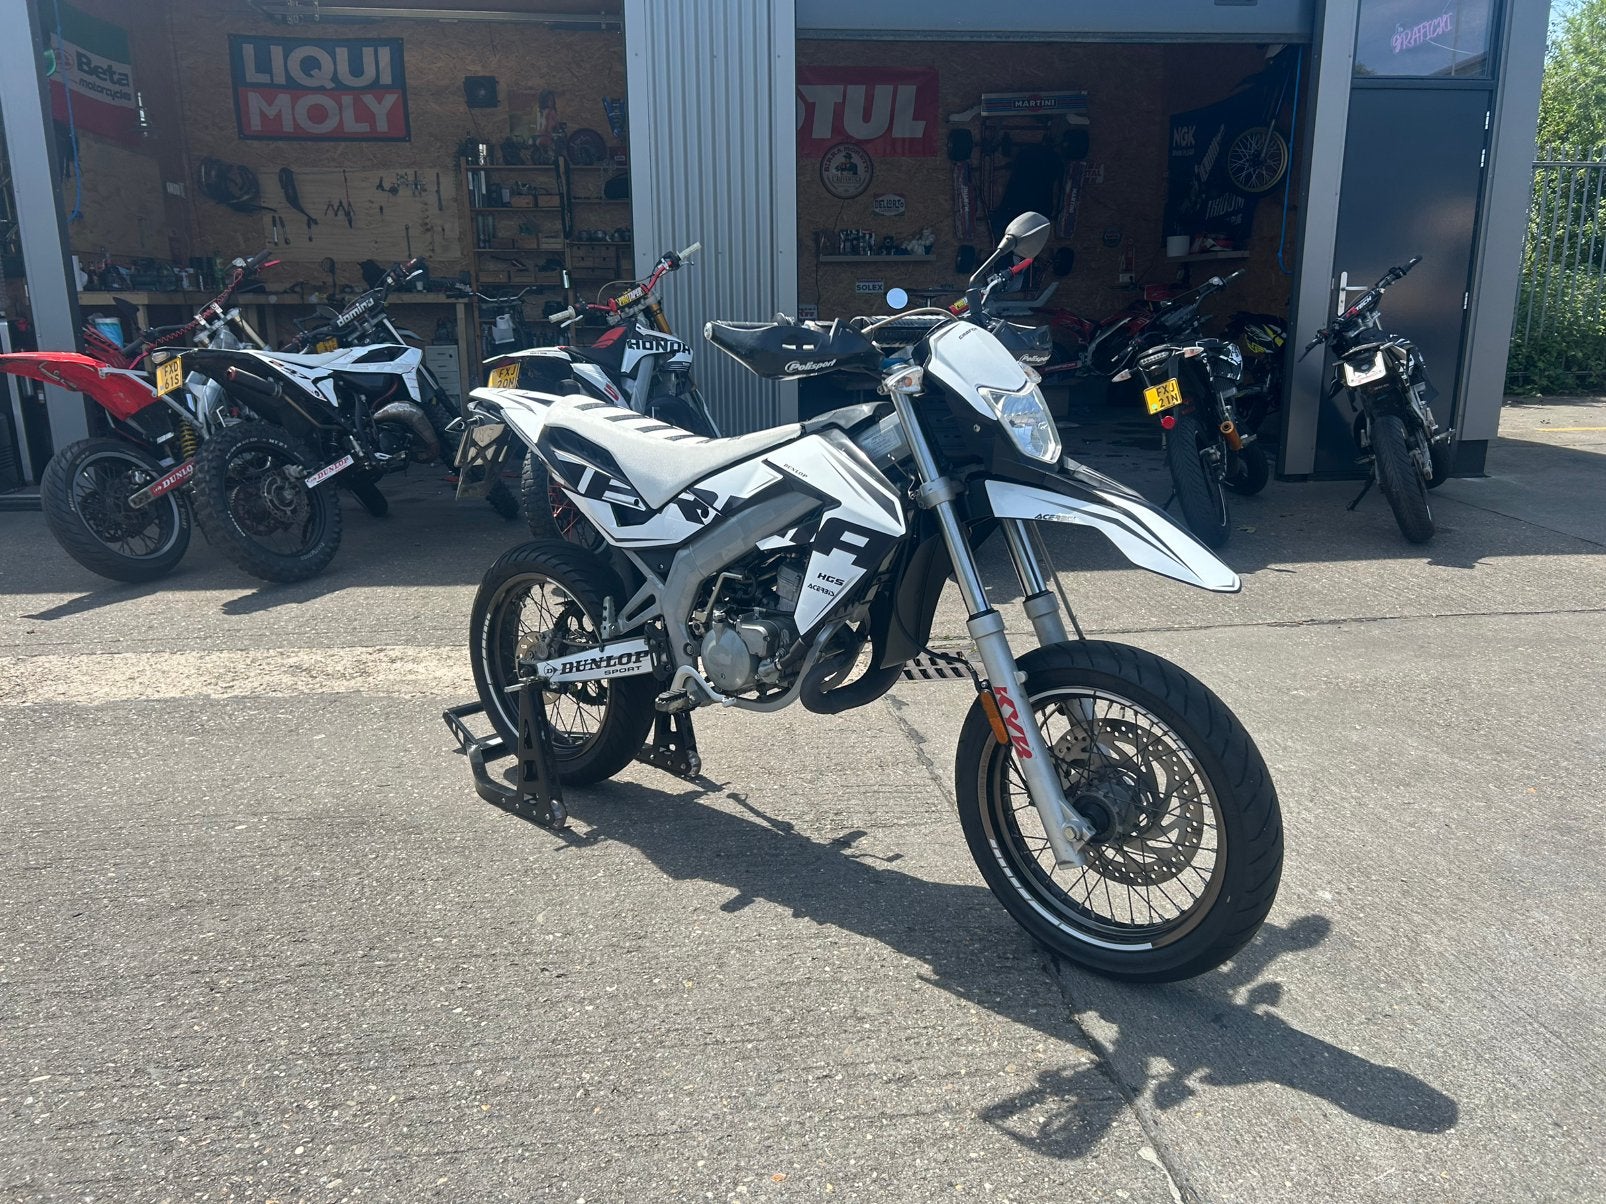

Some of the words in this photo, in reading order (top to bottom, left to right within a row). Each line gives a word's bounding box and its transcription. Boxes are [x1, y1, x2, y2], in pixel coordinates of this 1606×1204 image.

[76, 50, 130, 88] Beta
[242, 44, 393, 89] LIQUI
[1014, 99, 1055, 109] MARTINI
[248, 92, 399, 134] MOLY
[797, 85, 927, 140] TUL
[1172, 125, 1197, 148] NGK
[856, 283, 883, 292] SOLEX
[626, 338, 692, 355] HONDA
[163, 361, 179, 377] FXD
[498, 366, 517, 378] FXJ
[784, 358, 838, 374] Polisport
[164, 374, 180, 390] 61S
[1156, 384, 1176, 397] FXJ
[1158, 393, 1179, 408] 21N
[316, 456, 350, 480] DUNLOP
[783, 463, 808, 478] DUNLOP
[161, 463, 196, 490] DUNLO
[817, 572, 846, 586] HGS
[807, 583, 836, 597] ACERBIS
[559, 649, 649, 675] DUNLOP
[604, 665, 643, 676] SPORT
